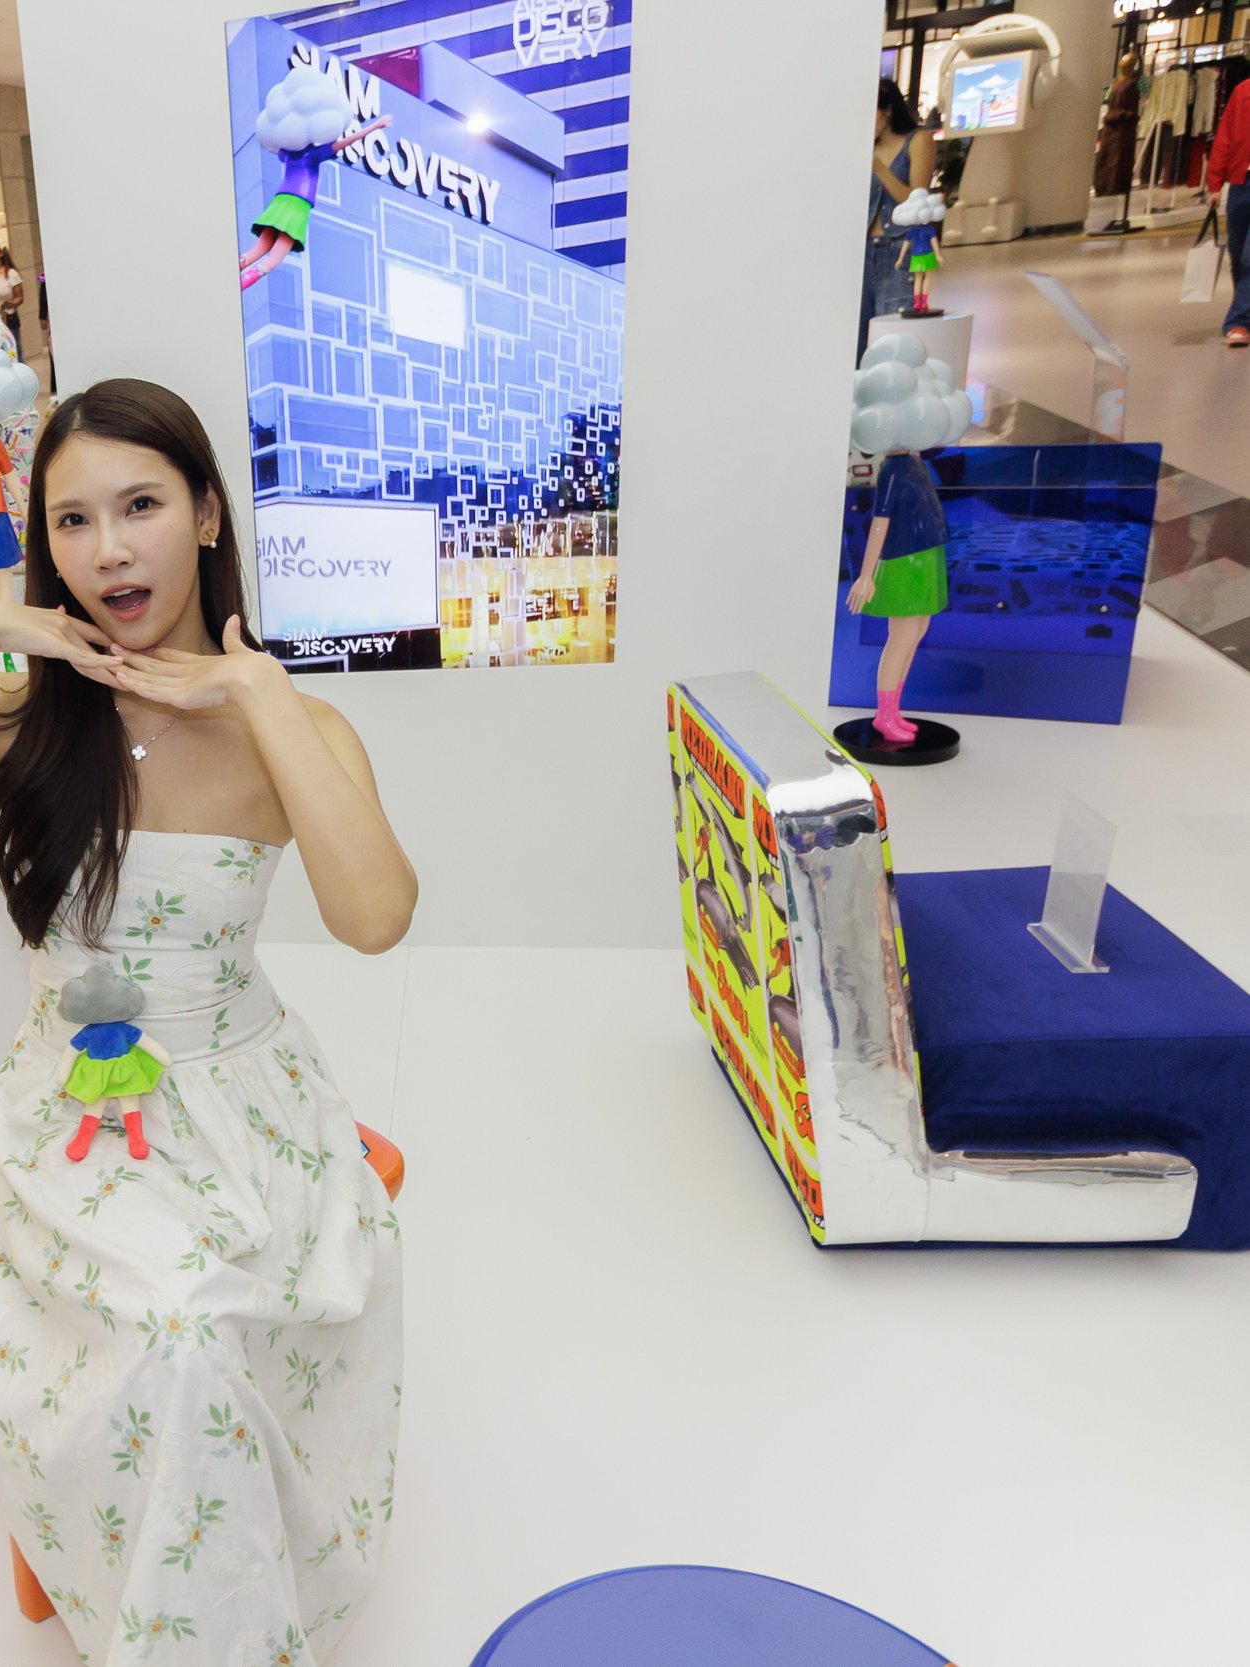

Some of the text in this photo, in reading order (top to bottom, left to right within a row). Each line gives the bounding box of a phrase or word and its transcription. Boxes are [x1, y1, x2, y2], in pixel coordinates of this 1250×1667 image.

[263, 558, 391, 578] DISCOVERY
[283, 626, 328, 642] SIAM
[293, 637, 396, 656] DISCOVERY
